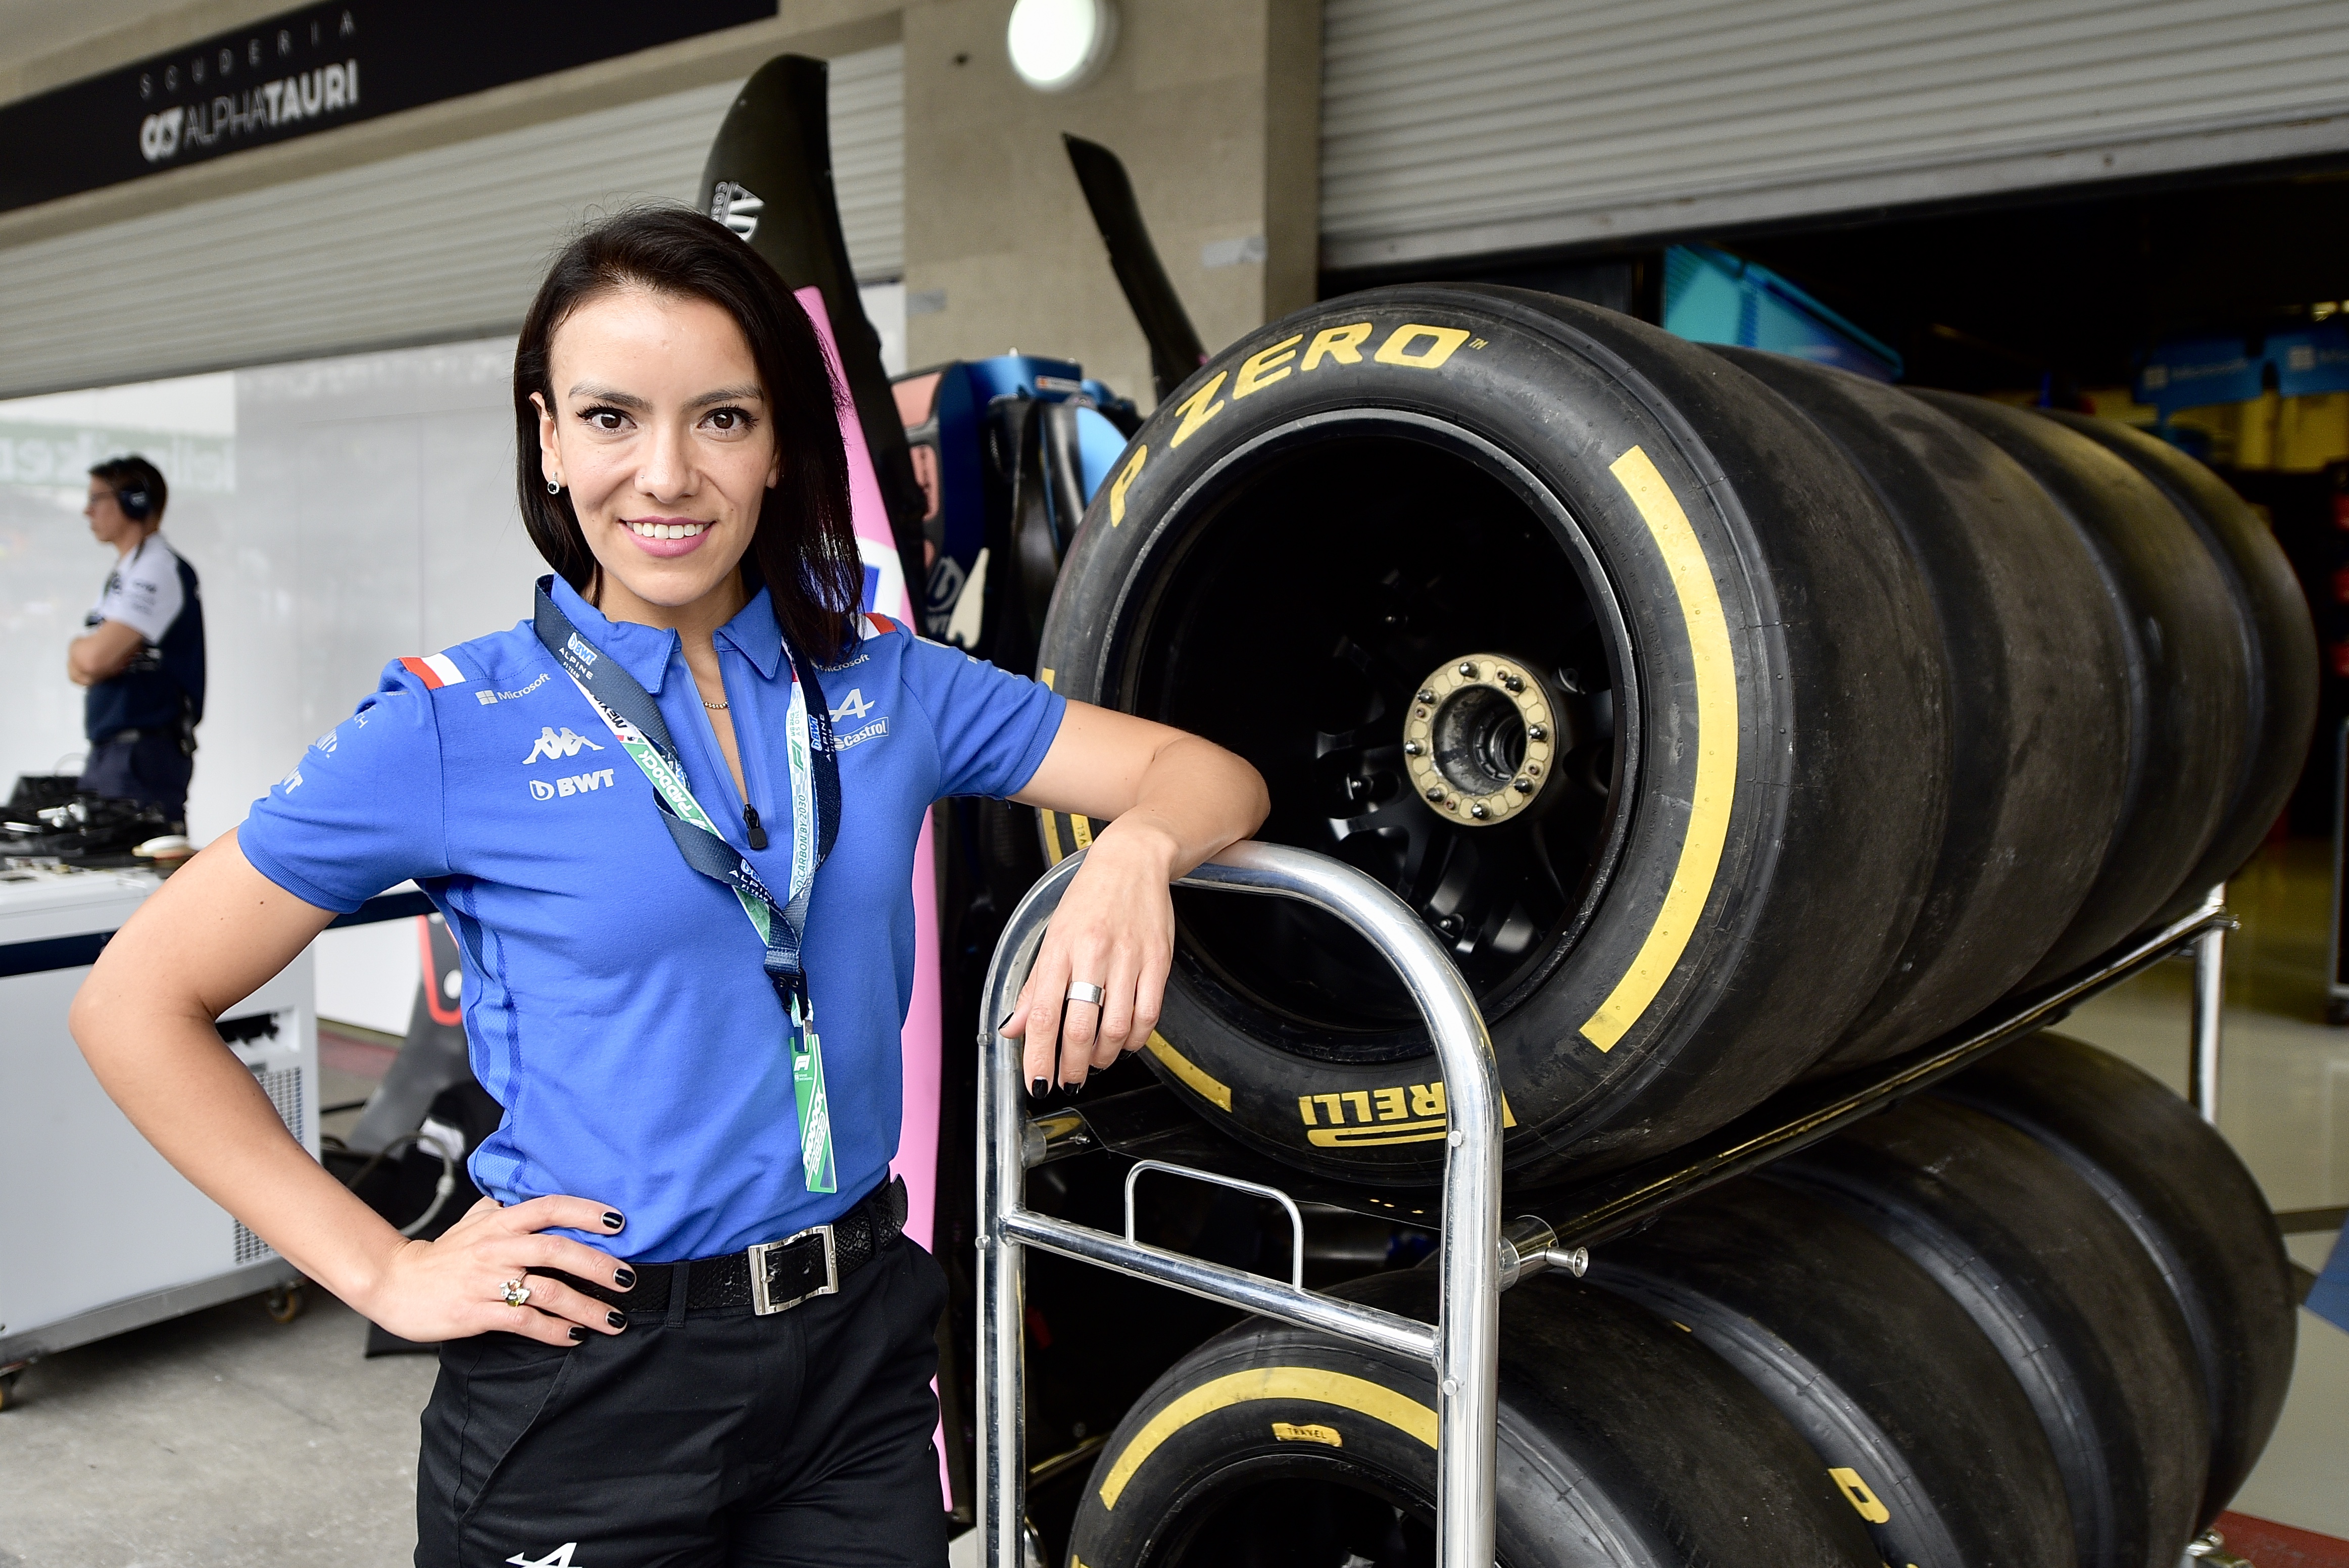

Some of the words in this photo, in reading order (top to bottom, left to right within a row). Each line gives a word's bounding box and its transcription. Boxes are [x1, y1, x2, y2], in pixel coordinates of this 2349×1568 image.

[138, 9, 355, 100] SCUDERIA
[184, 58, 358, 149] ALPHATAURI
[1110, 445, 1147, 528] P
[1169, 322, 1471, 449] ZERO
[558, 647, 594, 680] ALPINE
[573, 641, 598, 666] BWT
[568, 665, 580, 679] TEAM
[497, 672, 551, 701] Microsoft
[790, 727, 796, 737] WE
[796, 726, 801, 737] AS
[819, 713, 831, 762] ALPINE
[844, 720, 887, 747] Castrol
[556, 768, 614, 797] BWT
[638, 750, 693, 818] PADDOCK
[798, 795, 807, 820] 2030
[800, 822, 807, 835] BY
[1077, 823, 1087, 845] VEL
[797, 836, 807, 878] CARBON
[751, 889, 768, 902] TEAM
[803, 1084, 824, 1170] PADDOCK
[1287, 1427, 1327, 1439] TRAVEL
